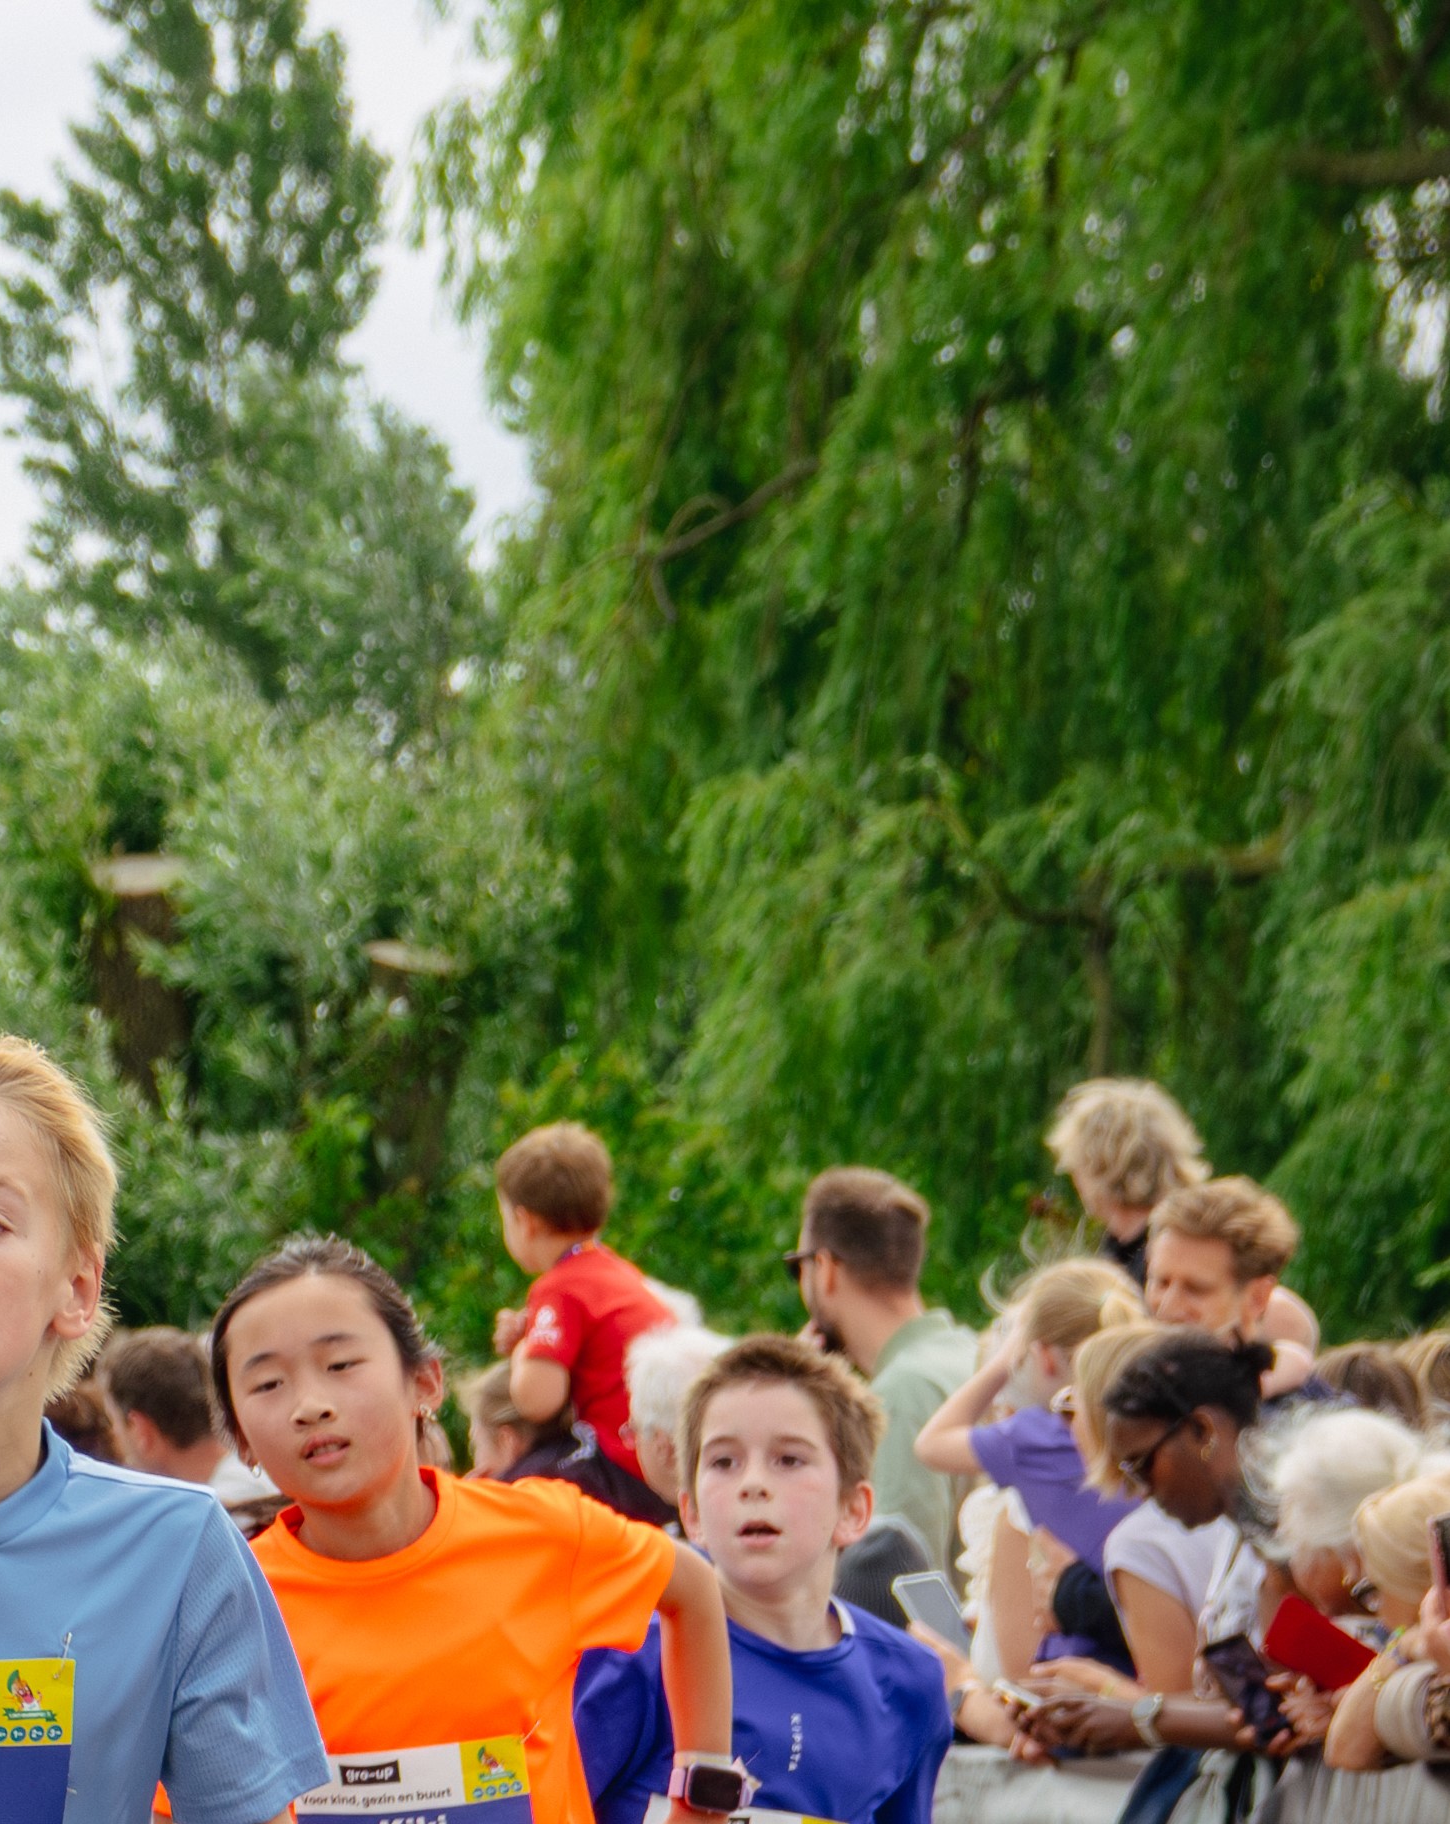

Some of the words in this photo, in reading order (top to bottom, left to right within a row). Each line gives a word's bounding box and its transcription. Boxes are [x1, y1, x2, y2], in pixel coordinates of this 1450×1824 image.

[346, 1766, 394, 1783] gro-up
[330, 1794, 359, 1807] kind,
[362, 1795, 394, 1809] gezin
[397, 1795, 414, 1803] en
[417, 1788, 451, 1801] buurt
